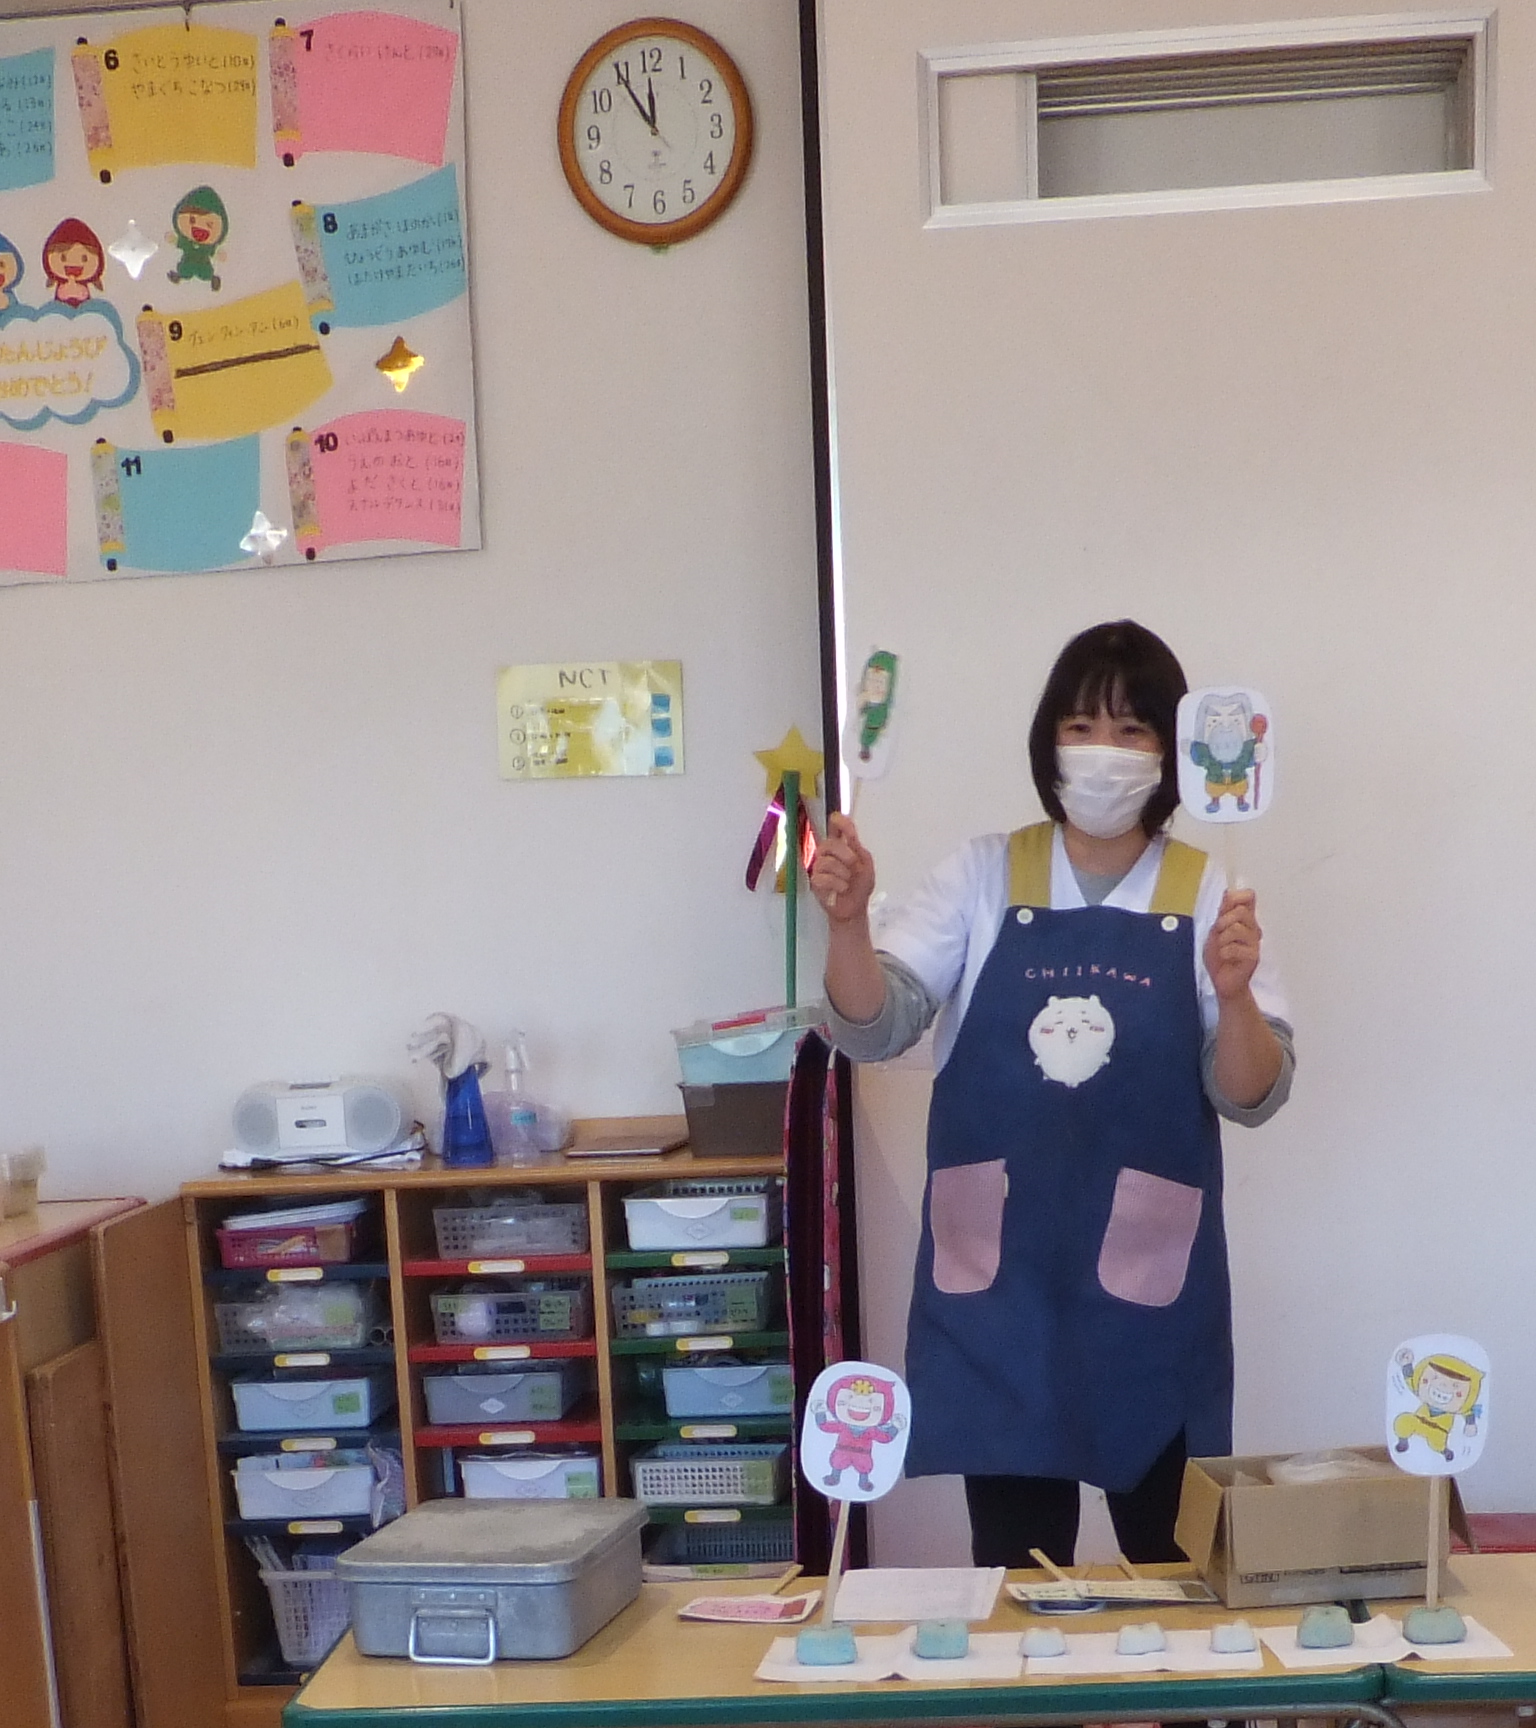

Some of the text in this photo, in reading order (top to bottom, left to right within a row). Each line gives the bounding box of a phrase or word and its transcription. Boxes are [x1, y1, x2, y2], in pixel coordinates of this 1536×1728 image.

[300, 30, 314, 52] 7
[104, 49, 119, 71] 6
[640, 47, 663, 74] 12
[679, 56, 687, 80] 1
[592, 88, 612, 114] 10
[700, 79, 713, 104] 2
[587, 125, 601, 150] 9
[710, 114, 723, 139] 3
[600, 160, 613, 185] 8
[704, 150, 715, 175] 4
[624, 184, 635, 209] 7
[653, 190, 666, 215] 6
[682, 179, 695, 204] 5
[323, 213, 338, 234] 8
[169, 320, 183, 341] 9
[314, 432, 339, 453] 10
[121, 456, 142, 476] 11
[558, 668, 612, 689] NCT
[1025, 963, 1153, 987] CHIIKAWA
